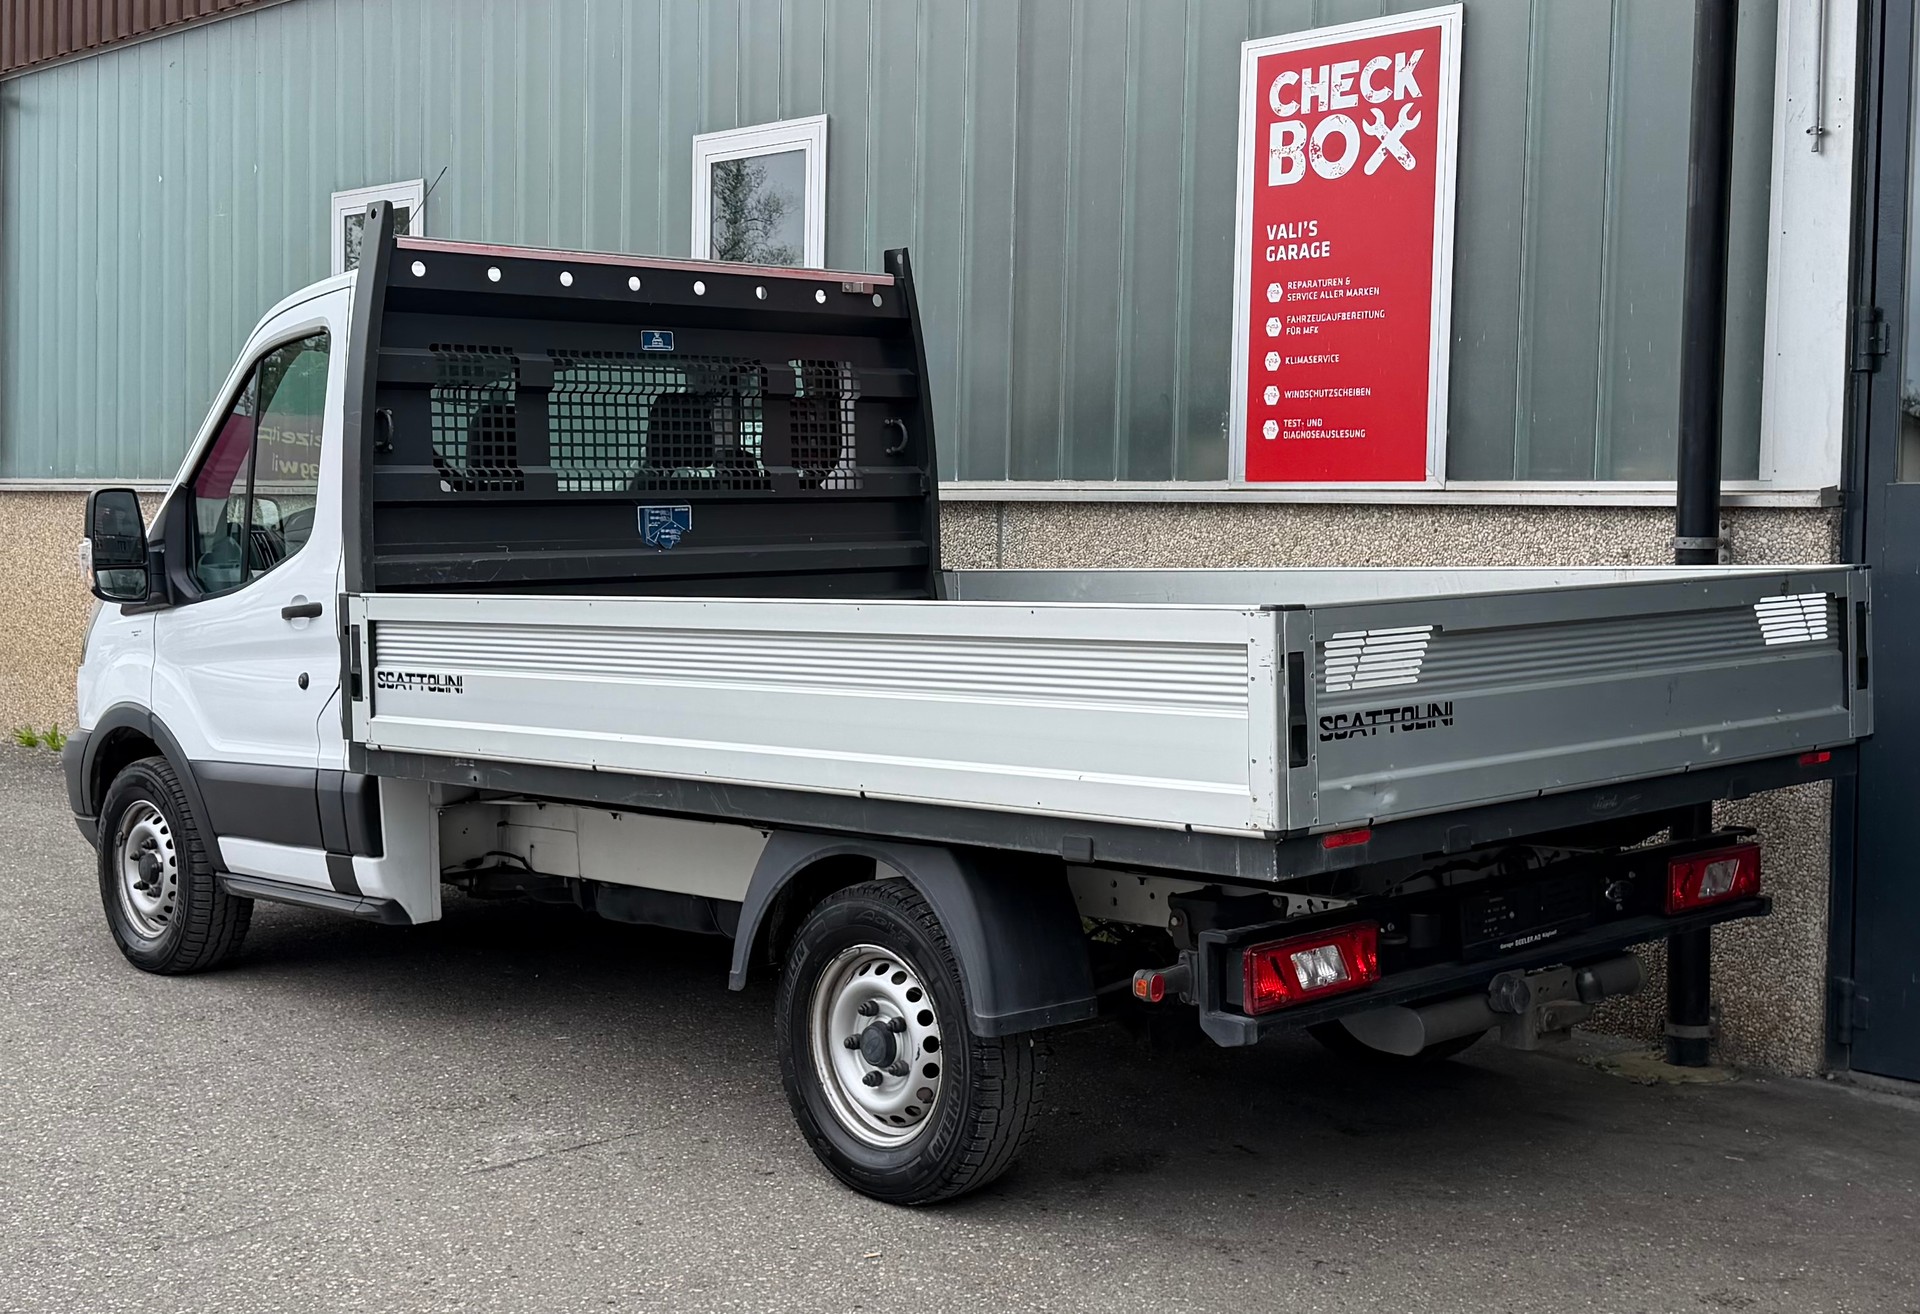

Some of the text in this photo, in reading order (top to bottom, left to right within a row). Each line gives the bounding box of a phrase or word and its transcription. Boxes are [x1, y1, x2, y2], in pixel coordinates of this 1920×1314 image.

[1269, 49, 1425, 117] CHECK
[1268, 103, 1422, 186] BOX
[1266, 220, 1318, 241] VALI'S
[1266, 240, 1331, 262] GARAGE
[1287, 276, 1351, 290] REPARATUREN &
[1287, 286, 1380, 302] SERVICE ALLER MARKEN
[1286, 309, 1386, 324] FAHRZEUGAUFBEREITUNG
[1286, 325, 1301, 336] FÜR
[1285, 353, 1340, 365] KLIMASERVICE
[1284, 387, 1371, 399] WINDSCHUTZSCHEIBEN
[1283, 418, 1323, 428] TEST- UND
[1283, 428, 1366, 439] DIAGNOSEAUSLESUNG
[377, 671, 463, 694] SCATTOLINI
[1319, 701, 1454, 742] SCATTOLINI
